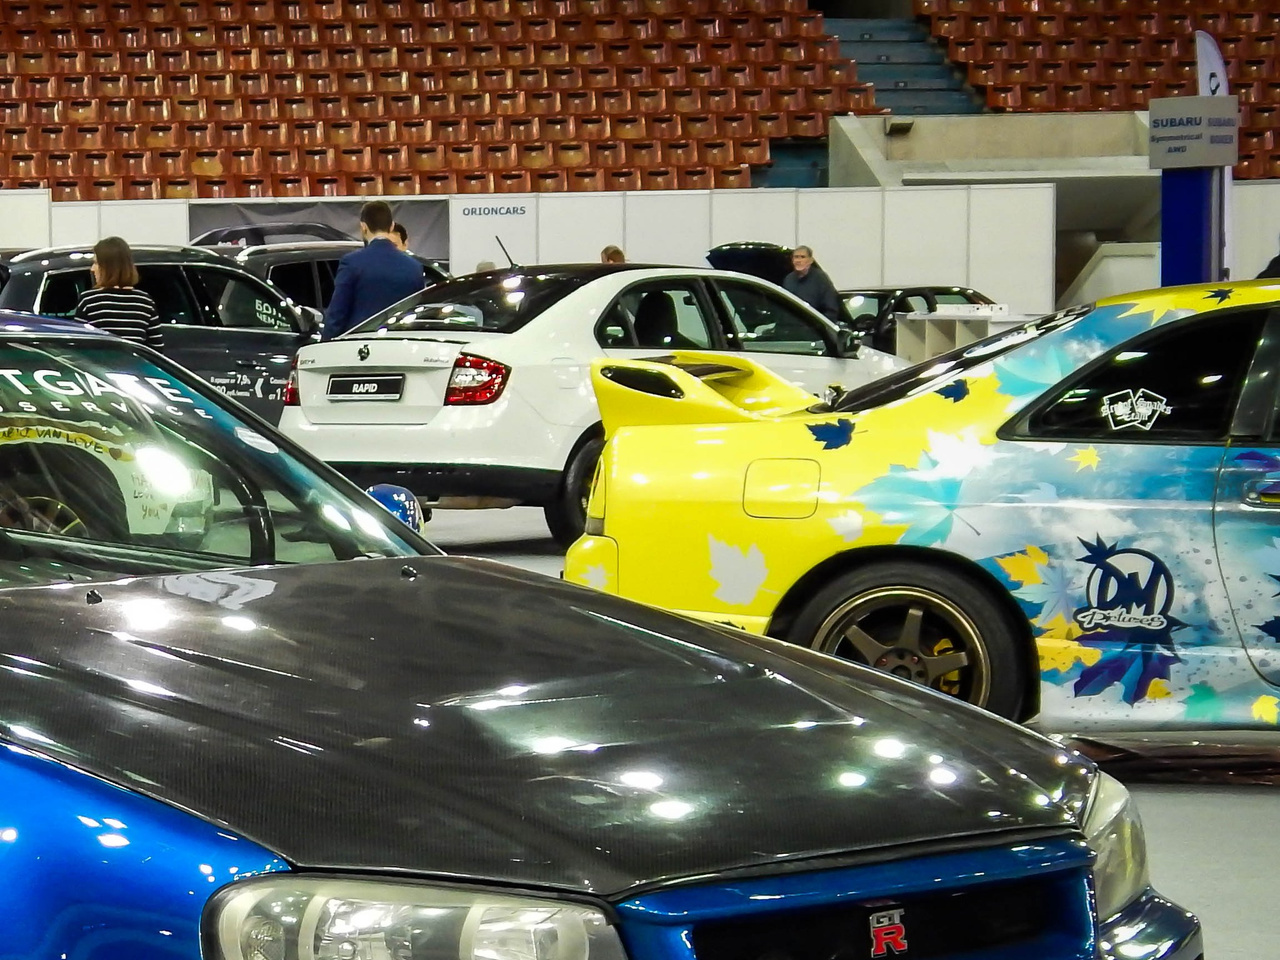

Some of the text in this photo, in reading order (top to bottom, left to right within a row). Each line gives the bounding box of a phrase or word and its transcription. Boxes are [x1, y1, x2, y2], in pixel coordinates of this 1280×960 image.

[1152, 117, 1202, 128] SUBARU
[462, 206, 526, 216] ORIONCARS
[352, 383, 378, 393] RAPID
[869, 908, 905, 927] GT
[871, 923, 908, 958] R
